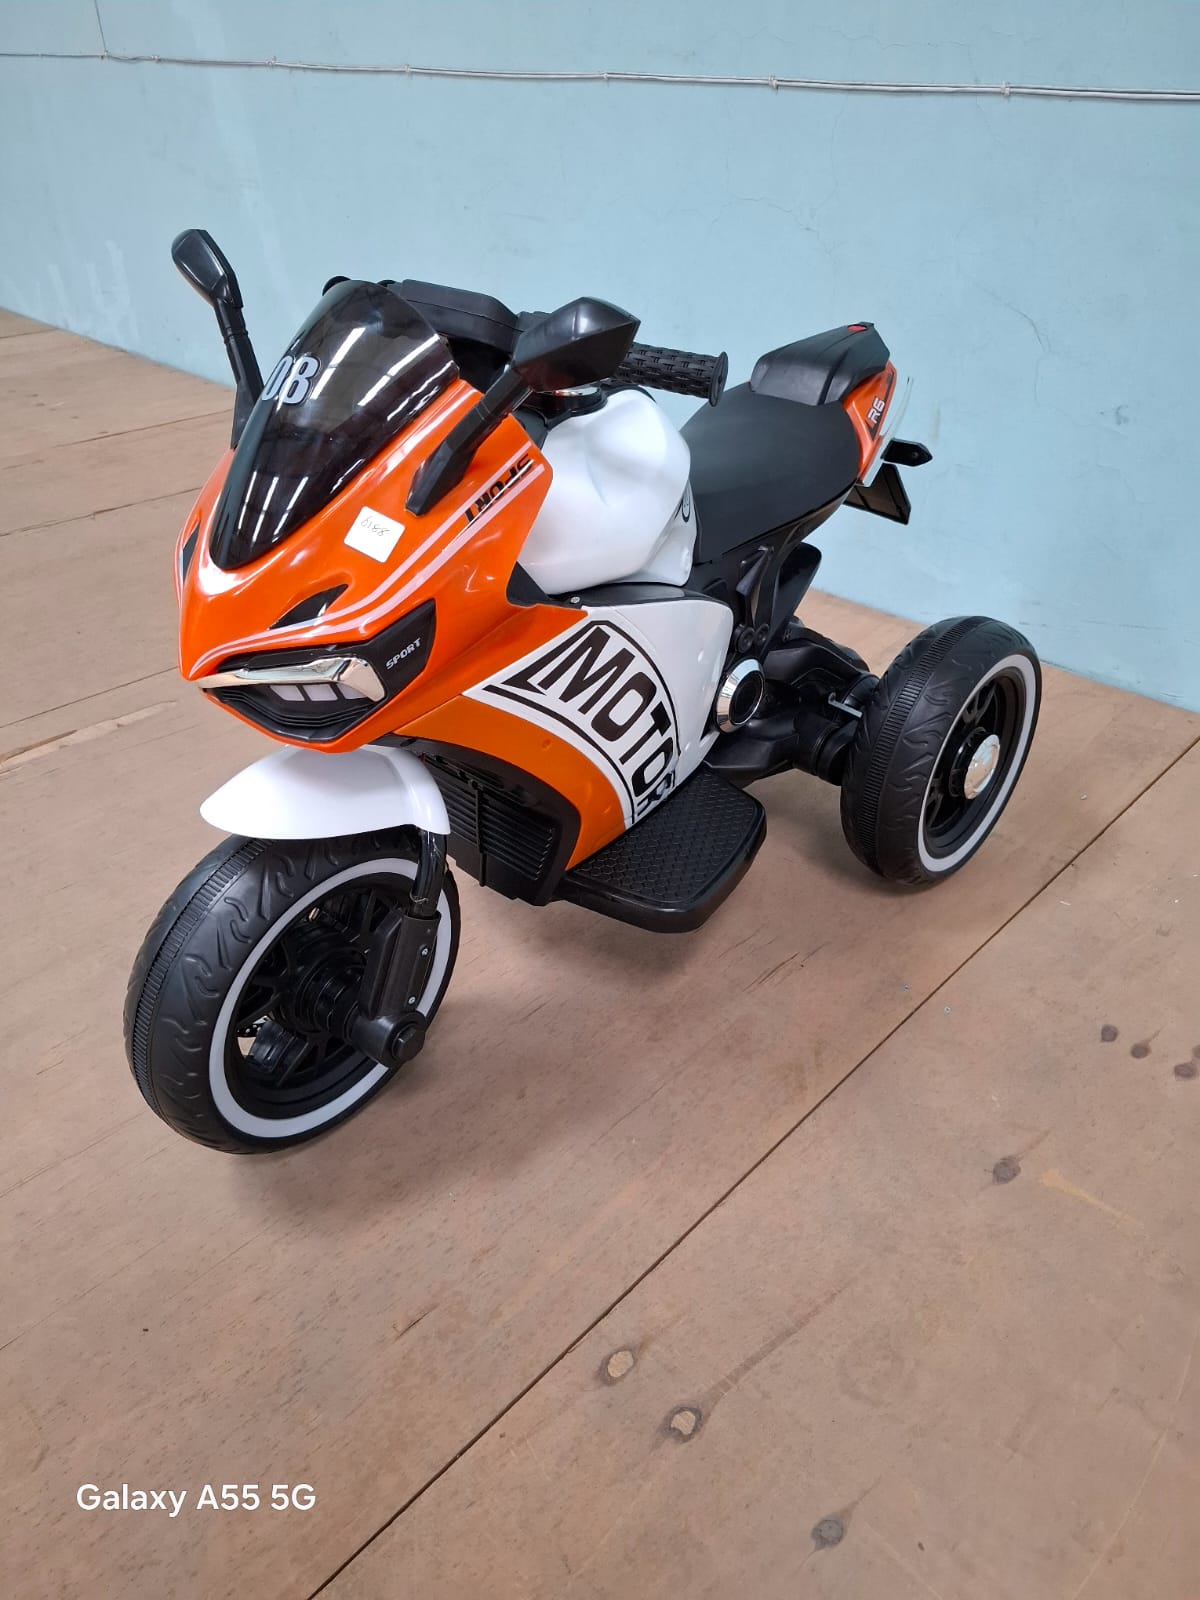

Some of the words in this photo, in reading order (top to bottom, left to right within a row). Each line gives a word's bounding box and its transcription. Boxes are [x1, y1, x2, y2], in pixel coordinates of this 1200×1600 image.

[261, 355, 320, 404] 08
[867, 397, 886, 424] R6
[464, 453, 532, 528] SPORT
[386, 637, 421, 670] SPORT
